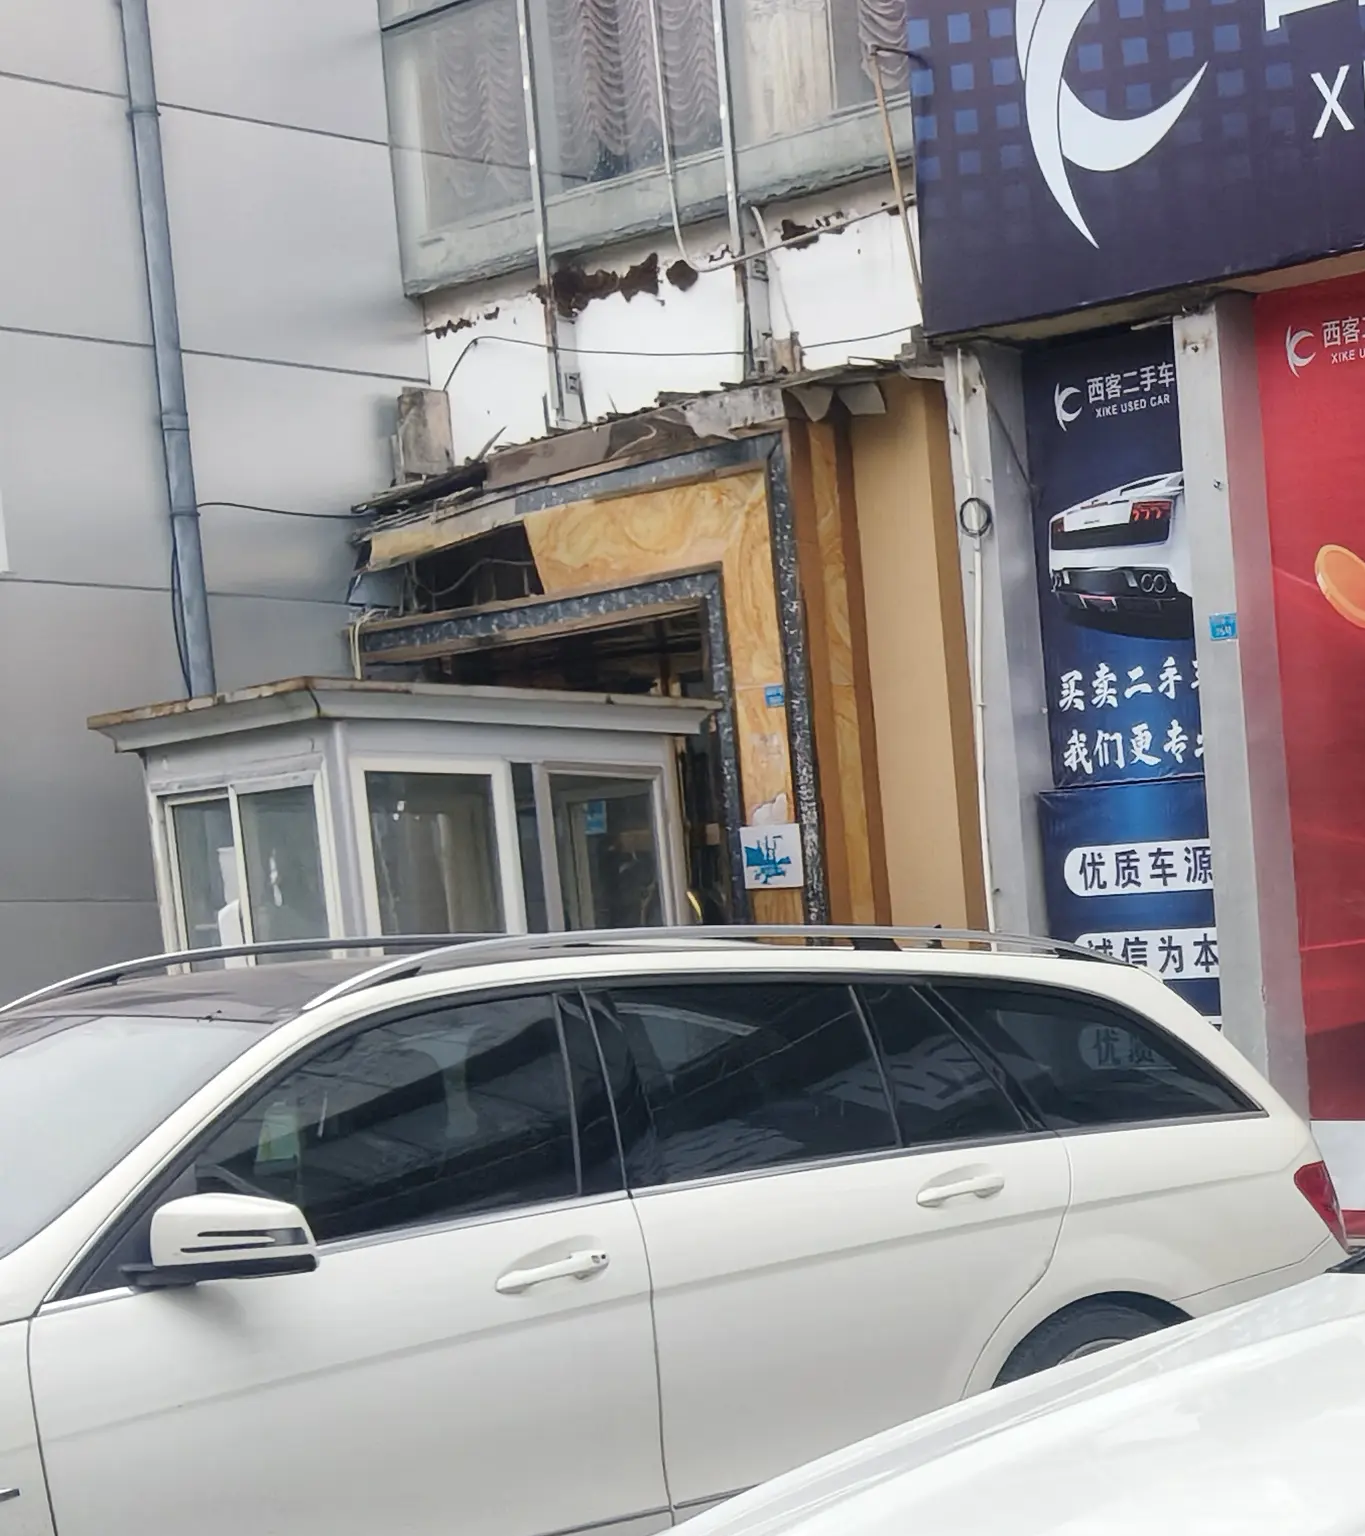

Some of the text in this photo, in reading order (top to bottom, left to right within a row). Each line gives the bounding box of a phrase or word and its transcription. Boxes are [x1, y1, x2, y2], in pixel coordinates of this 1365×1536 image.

[1331, 350, 1355, 364] XIKE
[1086, 361, 1175, 403] 西客二手车
[1096, 394, 1170, 418] XIKE USED CAR
[1059, 656, 1200, 712] 买卖二手
[1063, 719, 1204, 775] 我们更专
[1079, 847, 1213, 891] 优质车源
